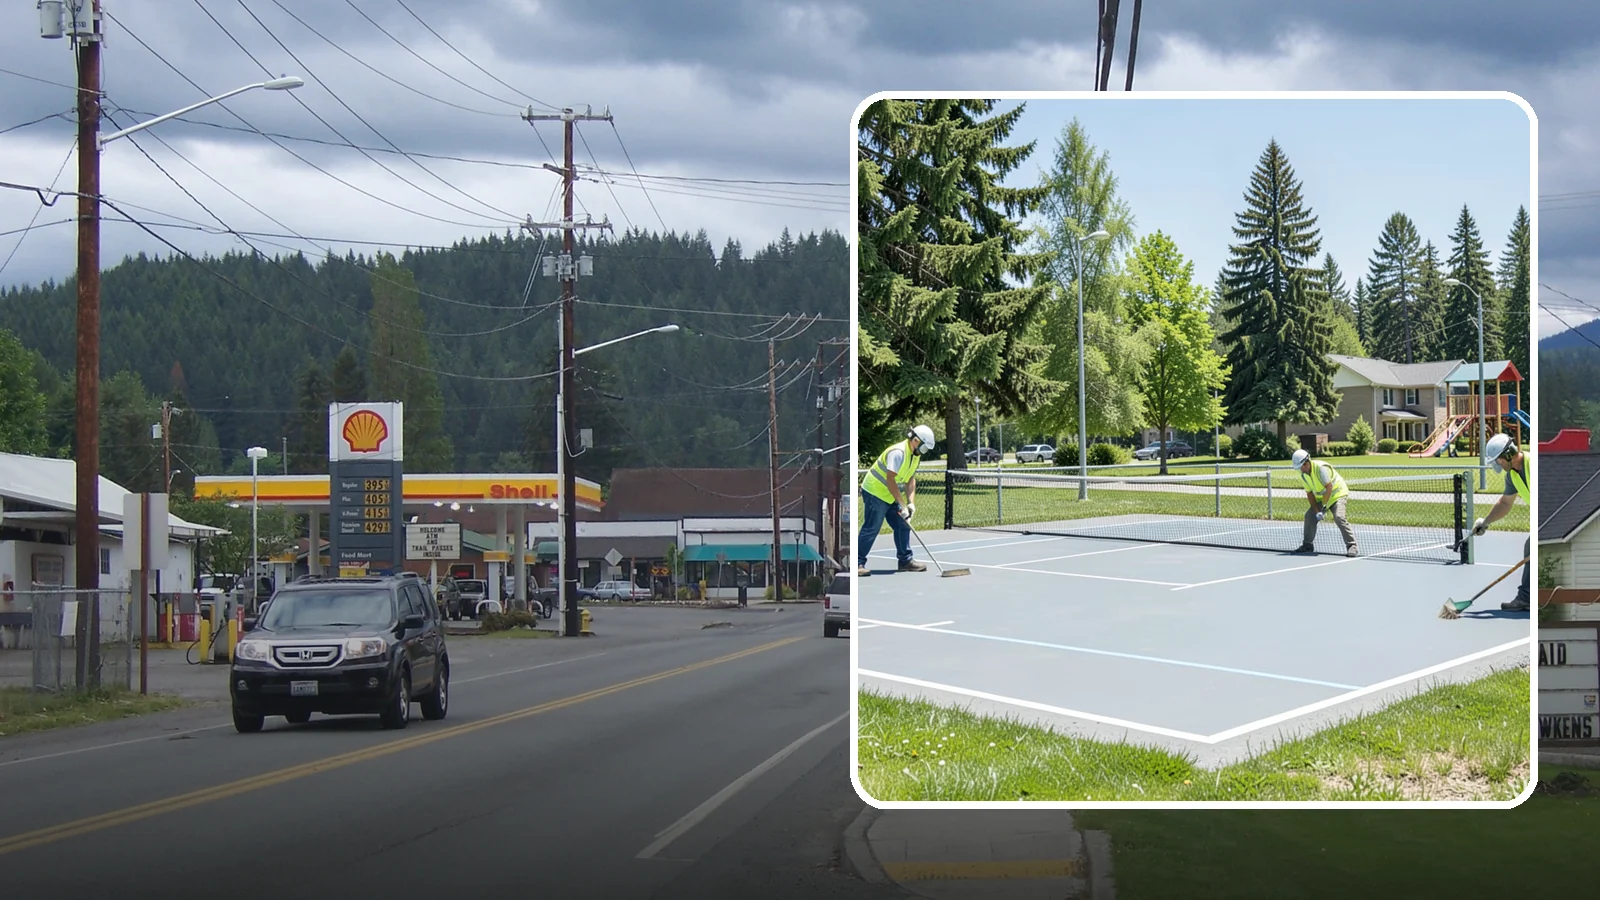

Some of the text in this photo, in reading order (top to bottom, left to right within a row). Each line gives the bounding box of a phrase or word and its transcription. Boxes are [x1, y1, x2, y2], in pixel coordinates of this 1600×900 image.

[366, 480, 383, 490] 395
[490, 484, 547, 499] Shell
[366, 494, 383, 504] 405
[366, 507, 383, 518] 415
[366, 522, 383, 532] 429
